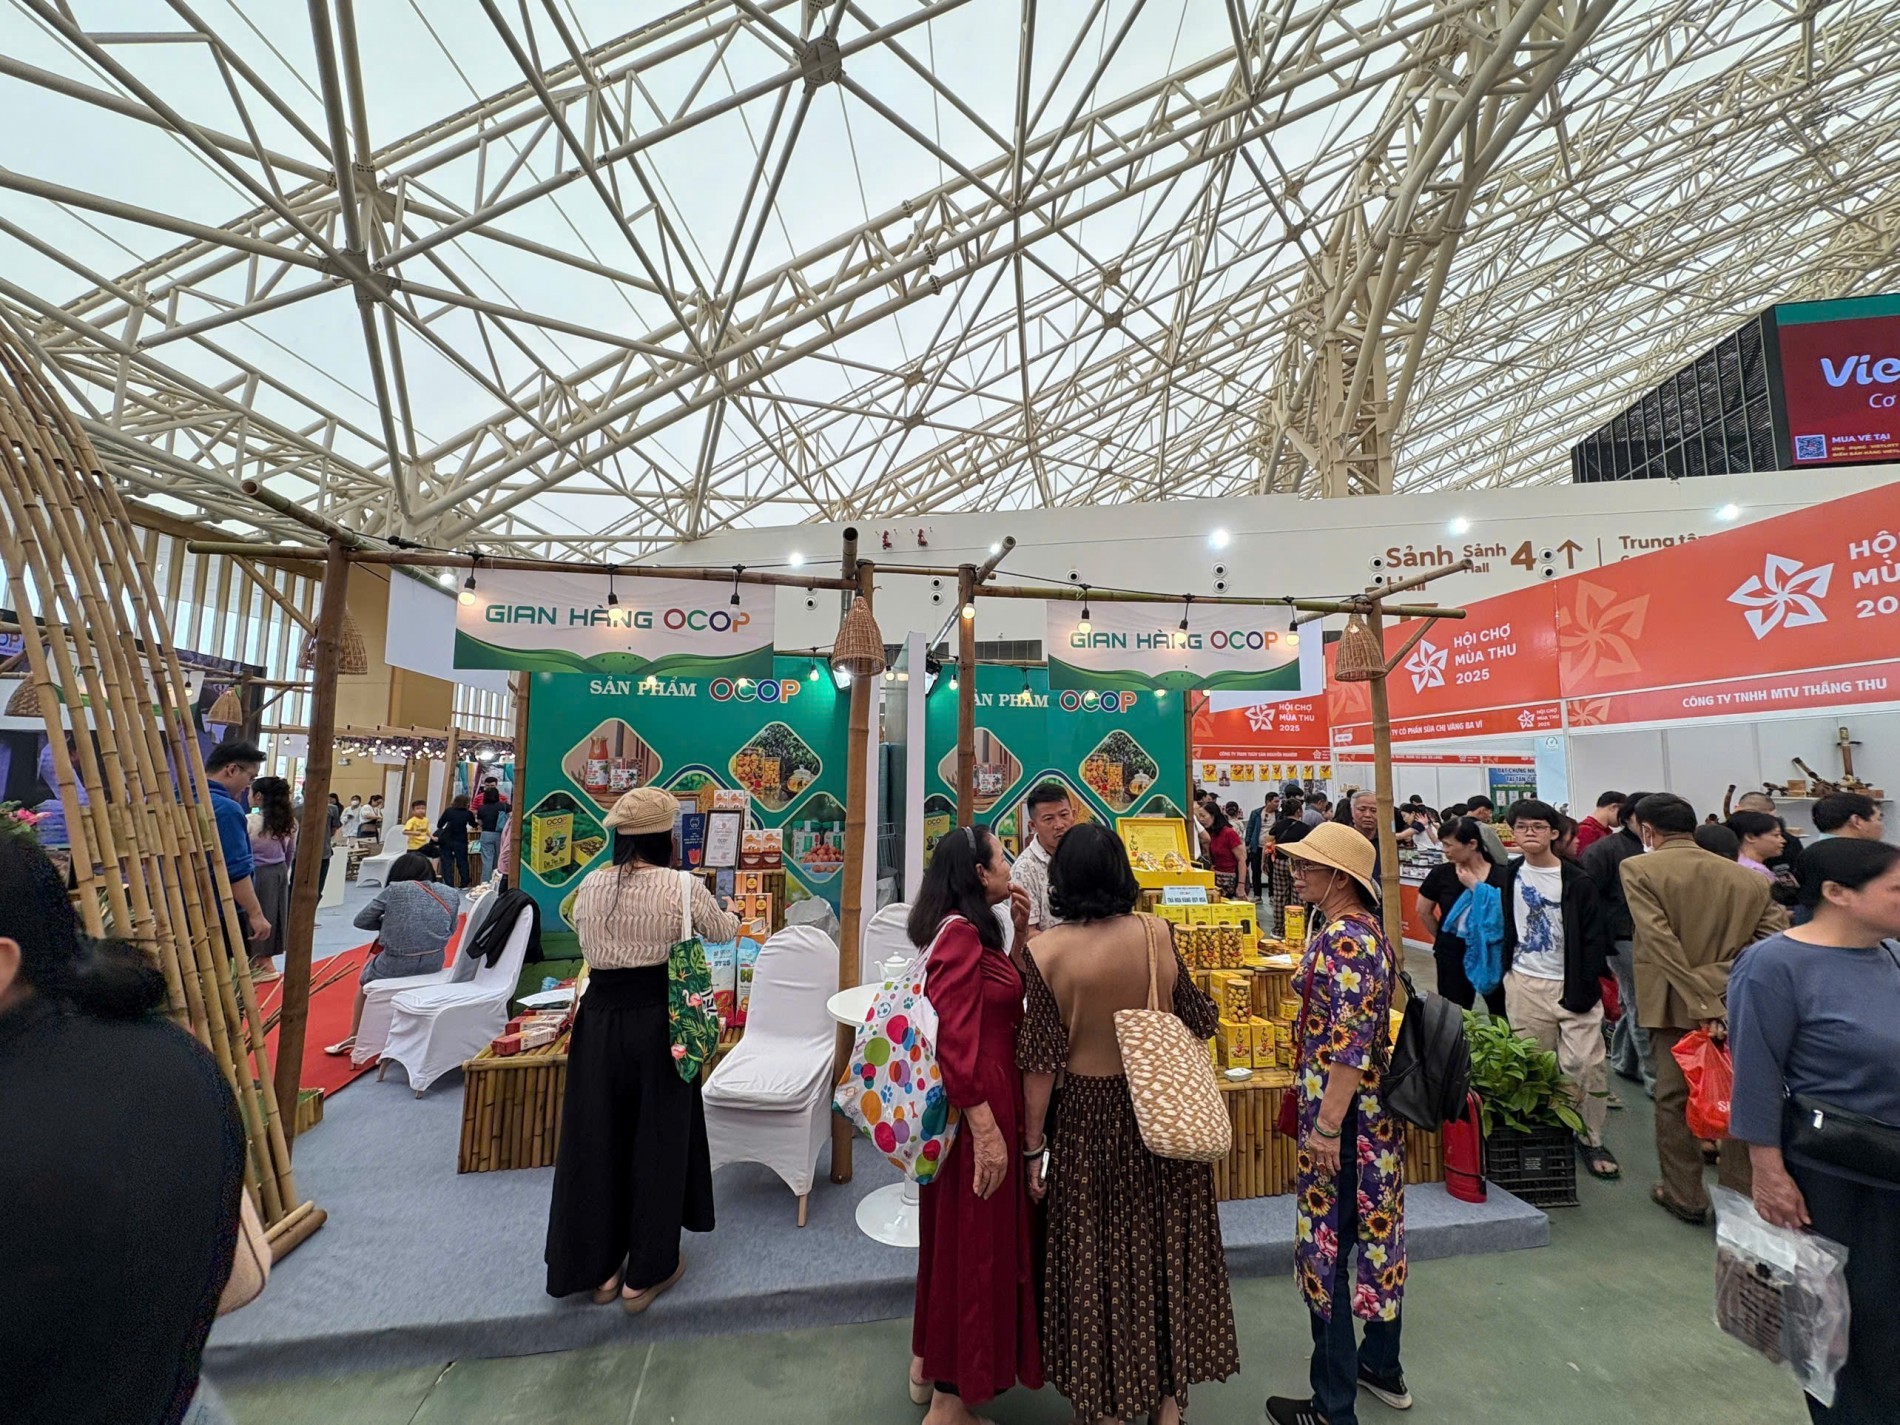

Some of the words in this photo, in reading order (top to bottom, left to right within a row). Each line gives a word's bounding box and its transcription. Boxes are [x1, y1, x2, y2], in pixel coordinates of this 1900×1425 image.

[1868, 393, 1897, 408] Cơ
[1873, 432, 1891, 442] TẠI
[1386, 545, 1454, 568] Sảnh
[1463, 543, 1507, 557] Sảnh
[1510, 540, 1537, 571] 4
[486, 604, 557, 625] GIAN
[569, 604, 653, 629] HÀNG
[663, 608, 750, 633] OCOP
[1856, 595, 1899, 619] 20
[1070, 632, 1127, 649] GIAN
[1136, 629, 1203, 649] HÀNG
[1210, 630, 1279, 650] OCOP
[1453, 631, 1477, 649] HỘI
[1480, 622, 1511, 641] CHỢ
[1455, 649, 1485, 667] MÙA
[1487, 643, 1517, 660] THU
[590, 676, 632, 696] SẢN
[637, 676, 697, 697] PHẨM
[1455, 668, 1490, 685] 2025
[709, 677, 800, 703] OCOP
[1059, 689, 1137, 713] OCOP
[1682, 695, 1714, 708] CÔNG
[1716, 693, 1731, 704] TY
[1733, 689, 1767, 703] TNHH
[1770, 686, 1799, 699] MTV
[1855, 677, 1887, 692] THU
[1279, 724, 1300, 732] 2025
[1298, 713, 1315, 722] THU
